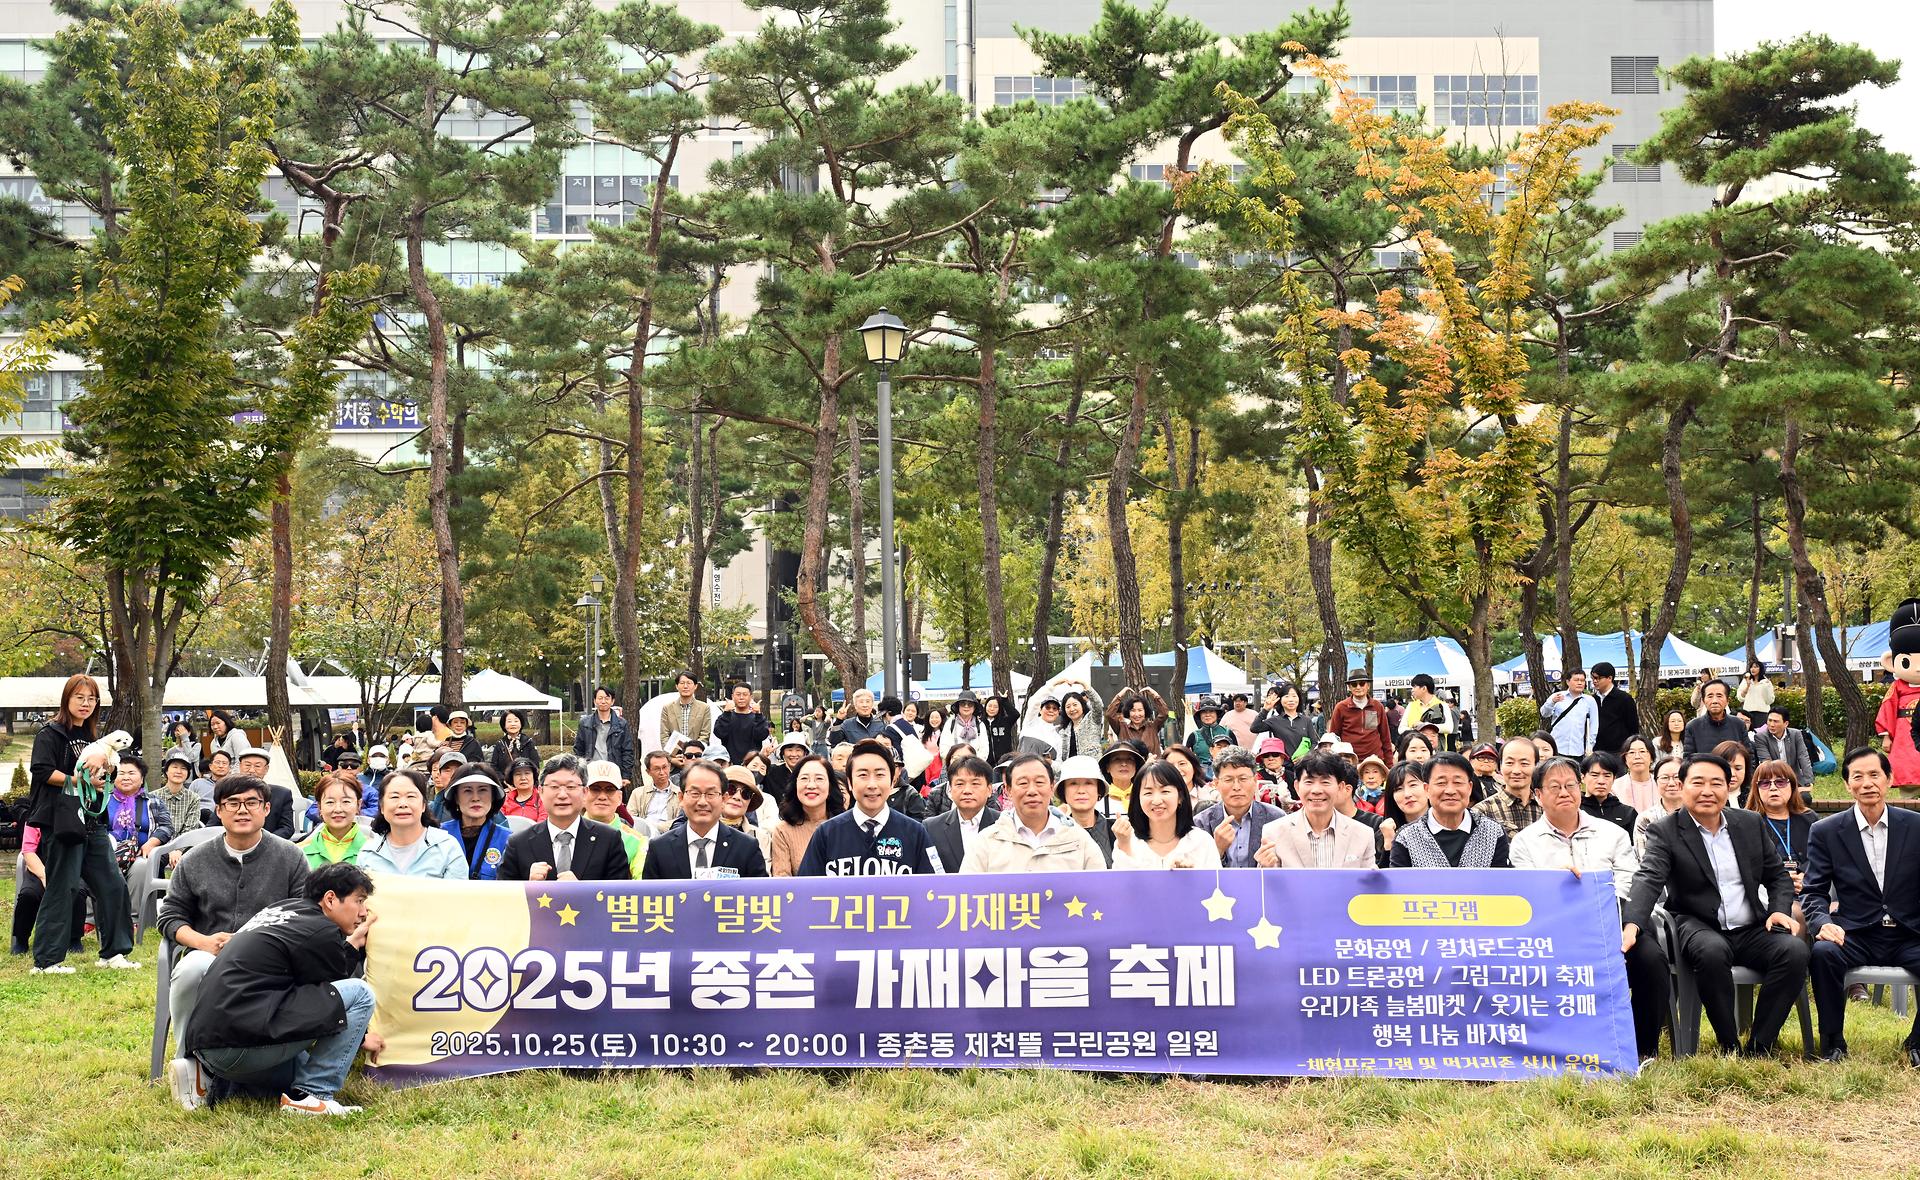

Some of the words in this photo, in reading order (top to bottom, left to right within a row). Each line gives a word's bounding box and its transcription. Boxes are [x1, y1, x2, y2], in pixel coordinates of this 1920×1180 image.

[808, 894, 912, 933] 그리고
[1402, 900, 1479, 921] 프로그램
[1334, 938, 1412, 960] 문화공연
[1436, 937, 1555, 959] 컬처로드공연
[414, 948, 671, 1010] 2025년
[690, 948, 815, 1010] 종촌
[835, 946, 1090, 1009] 가재마을
[1109, 943, 1236, 1008] 축제
[1299, 967, 1340, 986] LED
[1450, 964, 1548, 987] 그림그리기
[1555, 964, 1595, 987] 축제
[1300, 995, 1379, 1018] 우리가족
[1386, 994, 1467, 1017] 늘봄마켓
[1491, 993, 1550, 1017] 웃기는
[1556, 993, 1597, 1017] 경매
[432, 1032, 638, 1059] 2025.10.25(토)
[651, 1033, 727, 1056] 10:30
[766, 1033, 847, 1056] 20:00
[876, 1031, 956, 1058] 종촌동
[963, 1031, 1043, 1058] 제천뜰
[1052, 1031, 1157, 1058] 근린공원
[1167, 1030, 1219, 1058] 일원
[1372, 1023, 1413, 1048] 행복
[1420, 1023, 1459, 1047] 나눔
[1466, 1023, 1529, 1047] 바자회
